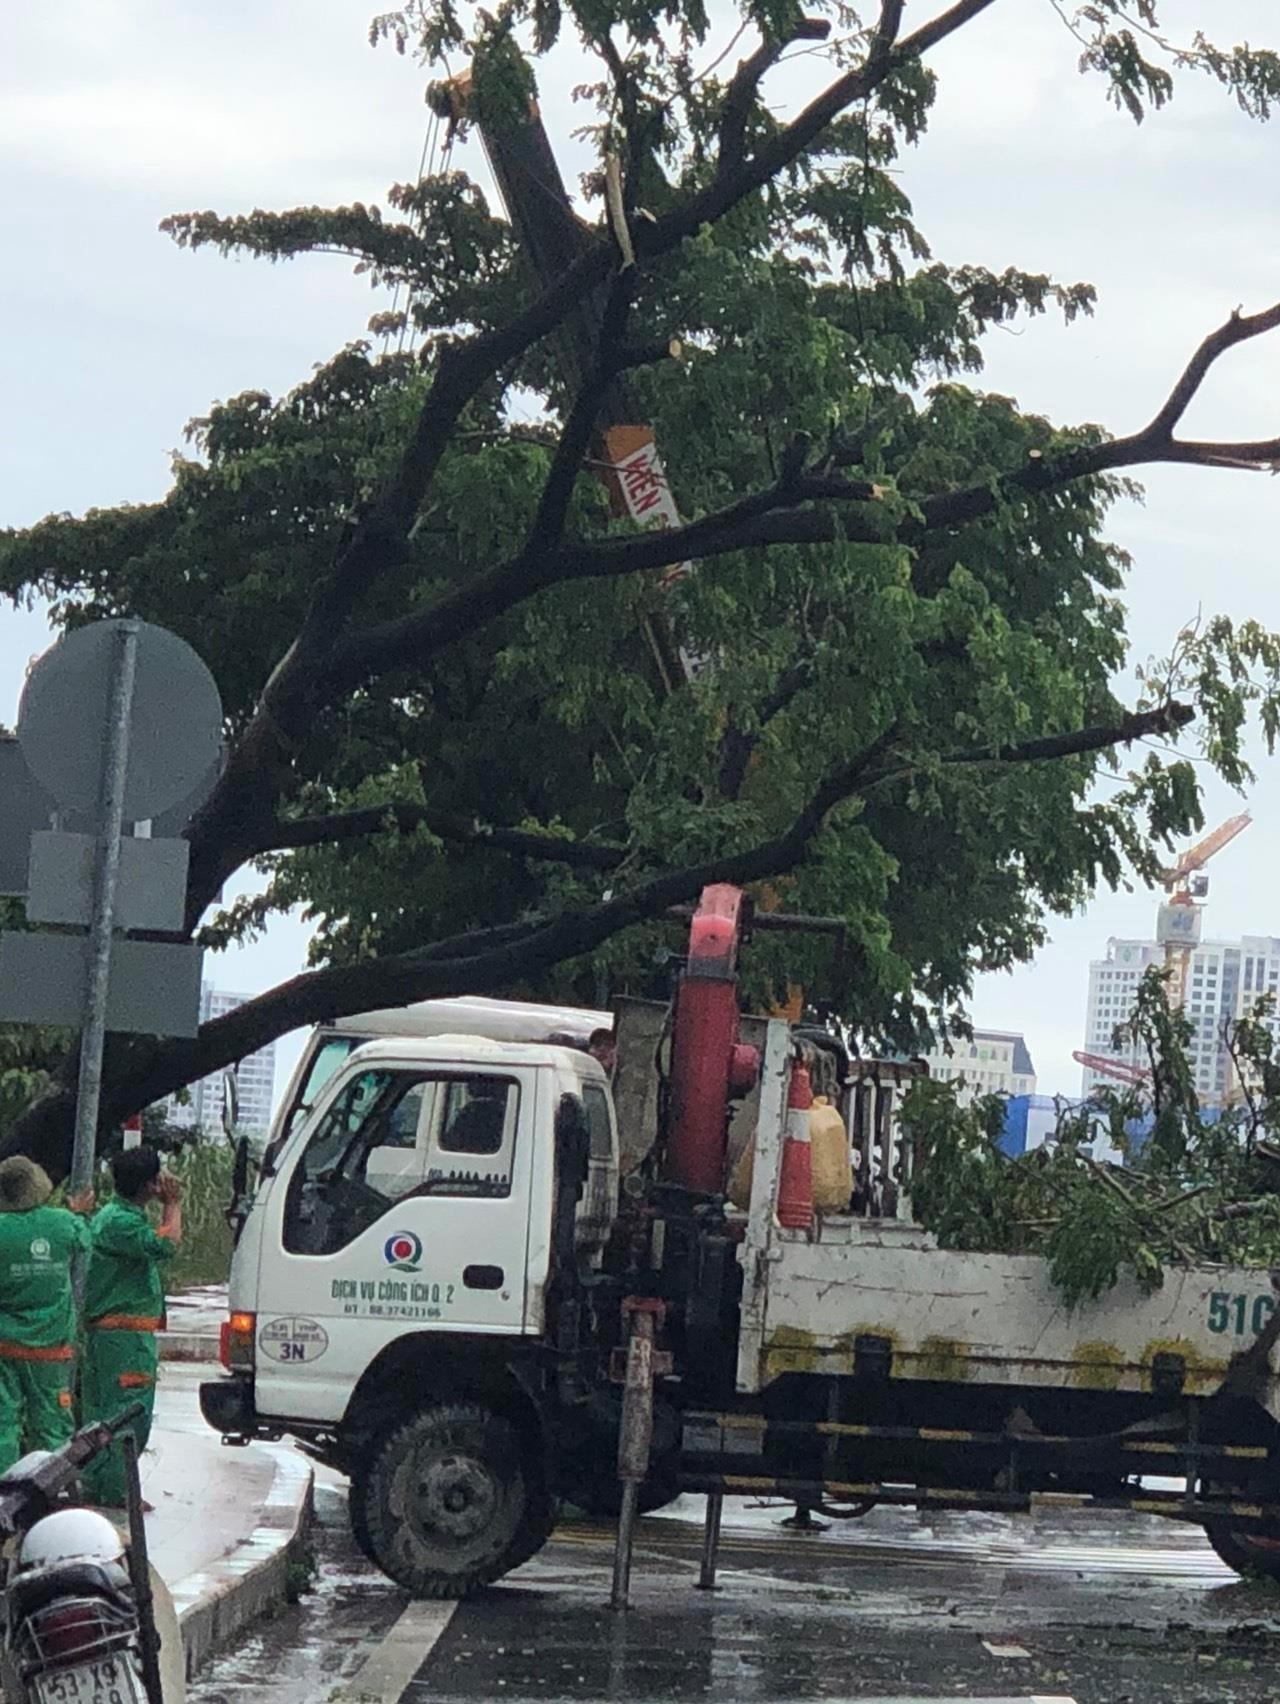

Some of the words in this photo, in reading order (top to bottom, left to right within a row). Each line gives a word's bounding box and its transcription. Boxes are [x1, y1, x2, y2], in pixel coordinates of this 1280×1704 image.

[360, 1281, 375, 1301] VỤ
[379, 1279, 407, 1301] CÔNG
[446, 1284, 454, 1304] 2
[280, 1343, 304, 1360] 3N
